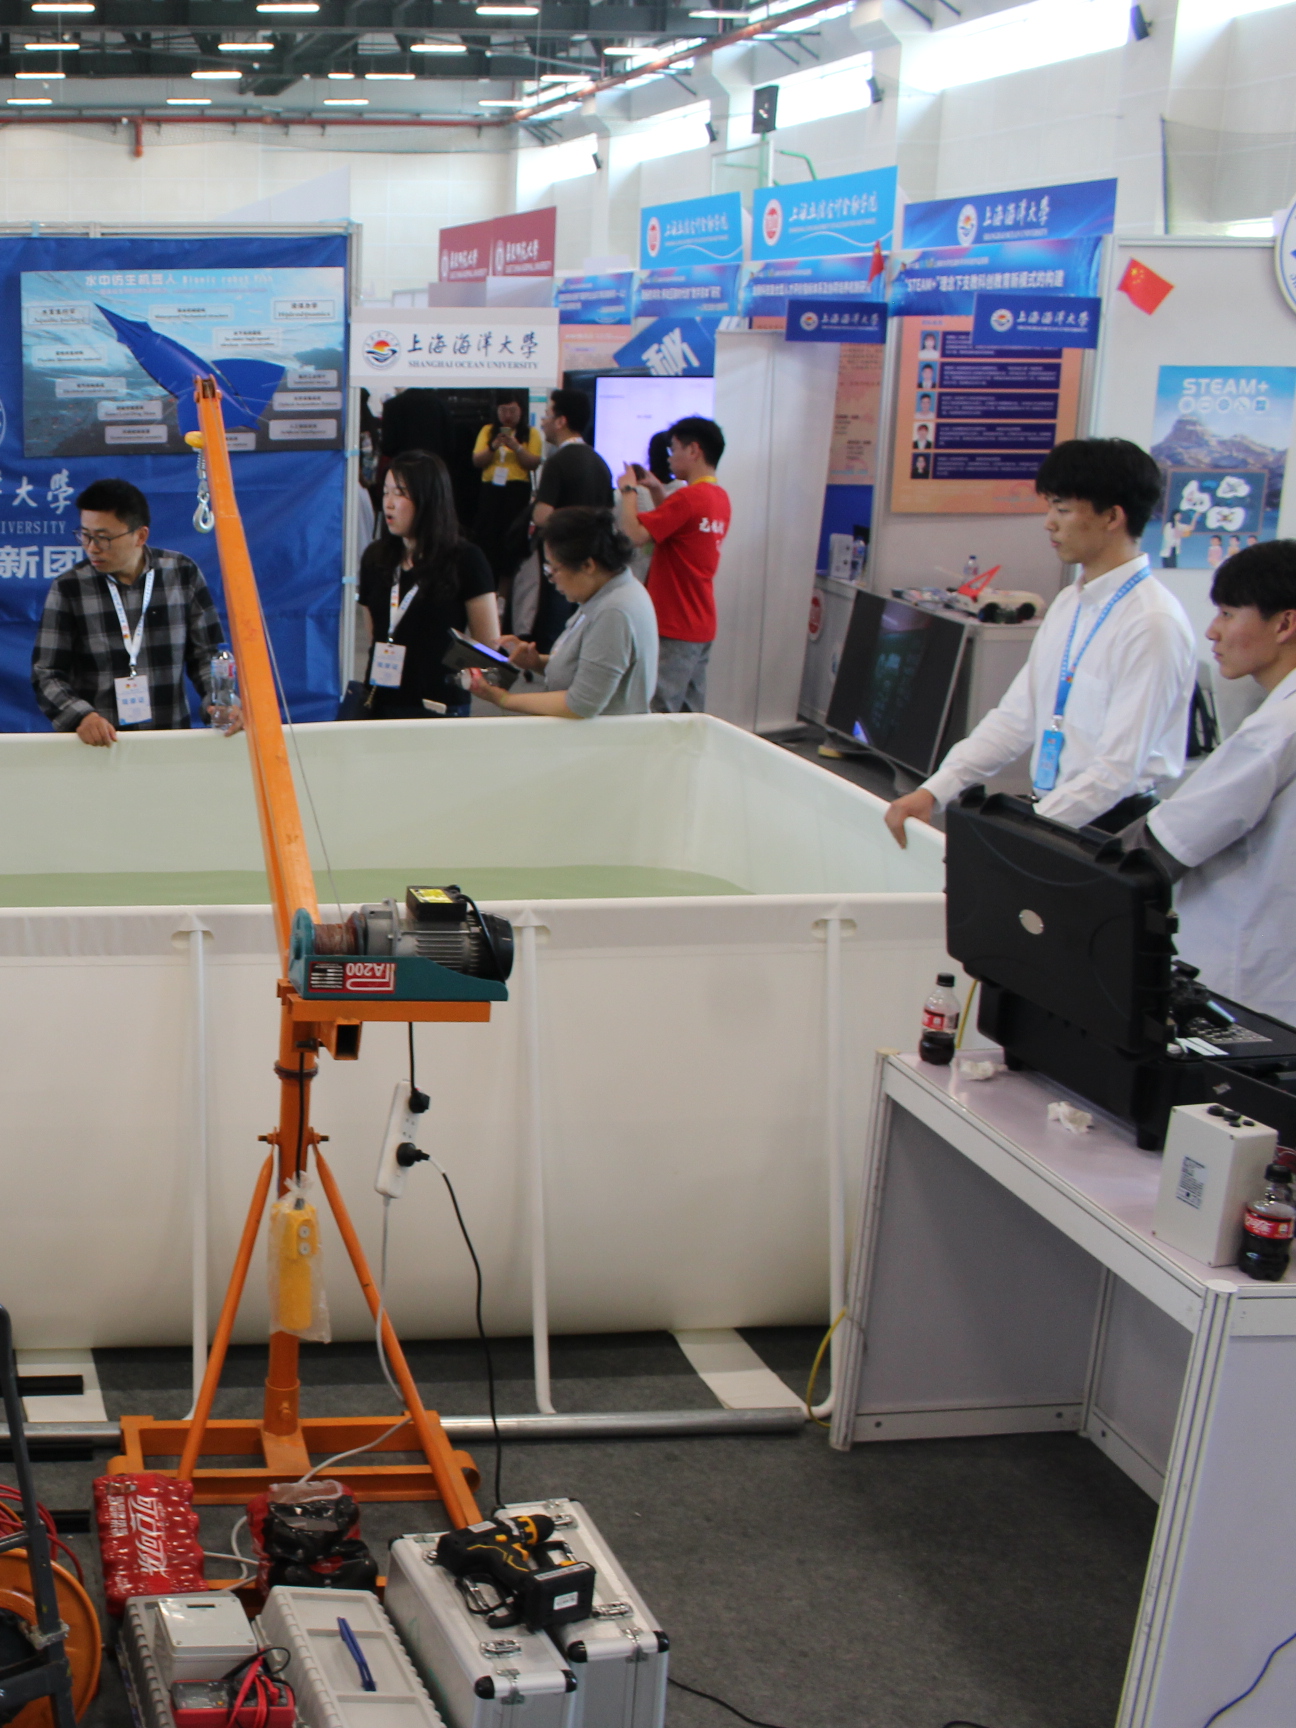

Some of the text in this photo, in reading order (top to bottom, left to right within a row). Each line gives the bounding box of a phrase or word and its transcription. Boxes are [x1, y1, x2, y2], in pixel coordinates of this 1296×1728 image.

[85, 274, 177, 286] 水中仿生机器人
[408, 360, 539, 369] SHANGHAI OCEAN UNIVERSITY
[1182, 378, 1270, 395] STEAM+
